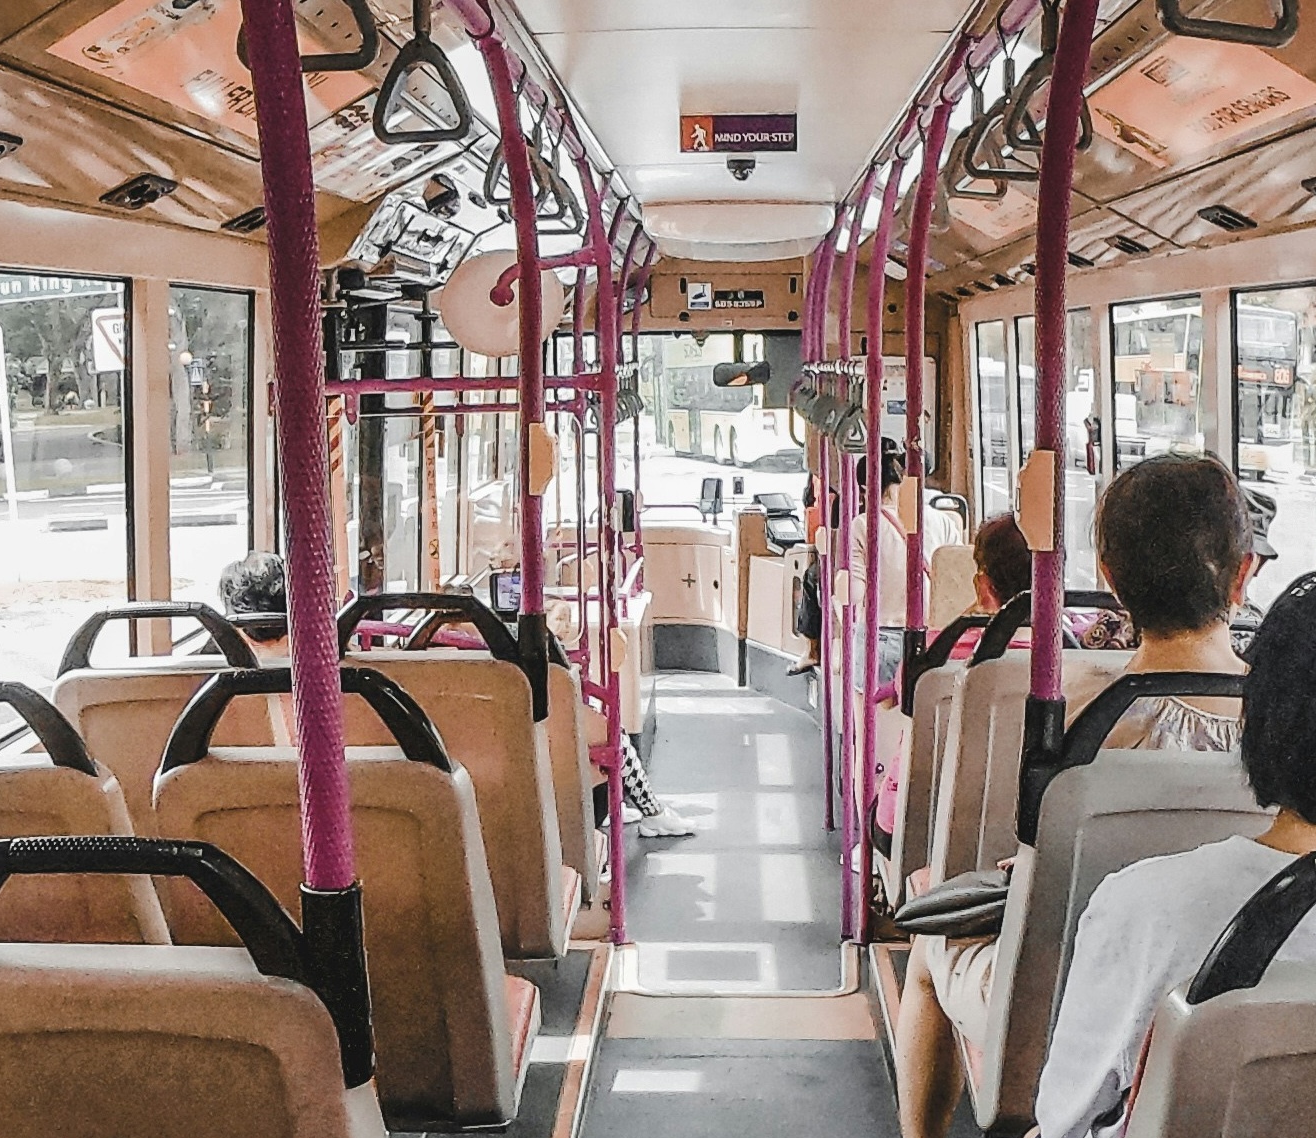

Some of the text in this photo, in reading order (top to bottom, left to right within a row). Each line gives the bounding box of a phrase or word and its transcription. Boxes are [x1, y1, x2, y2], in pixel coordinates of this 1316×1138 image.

[714, 132, 795, 143] MIND YOUR STEP
